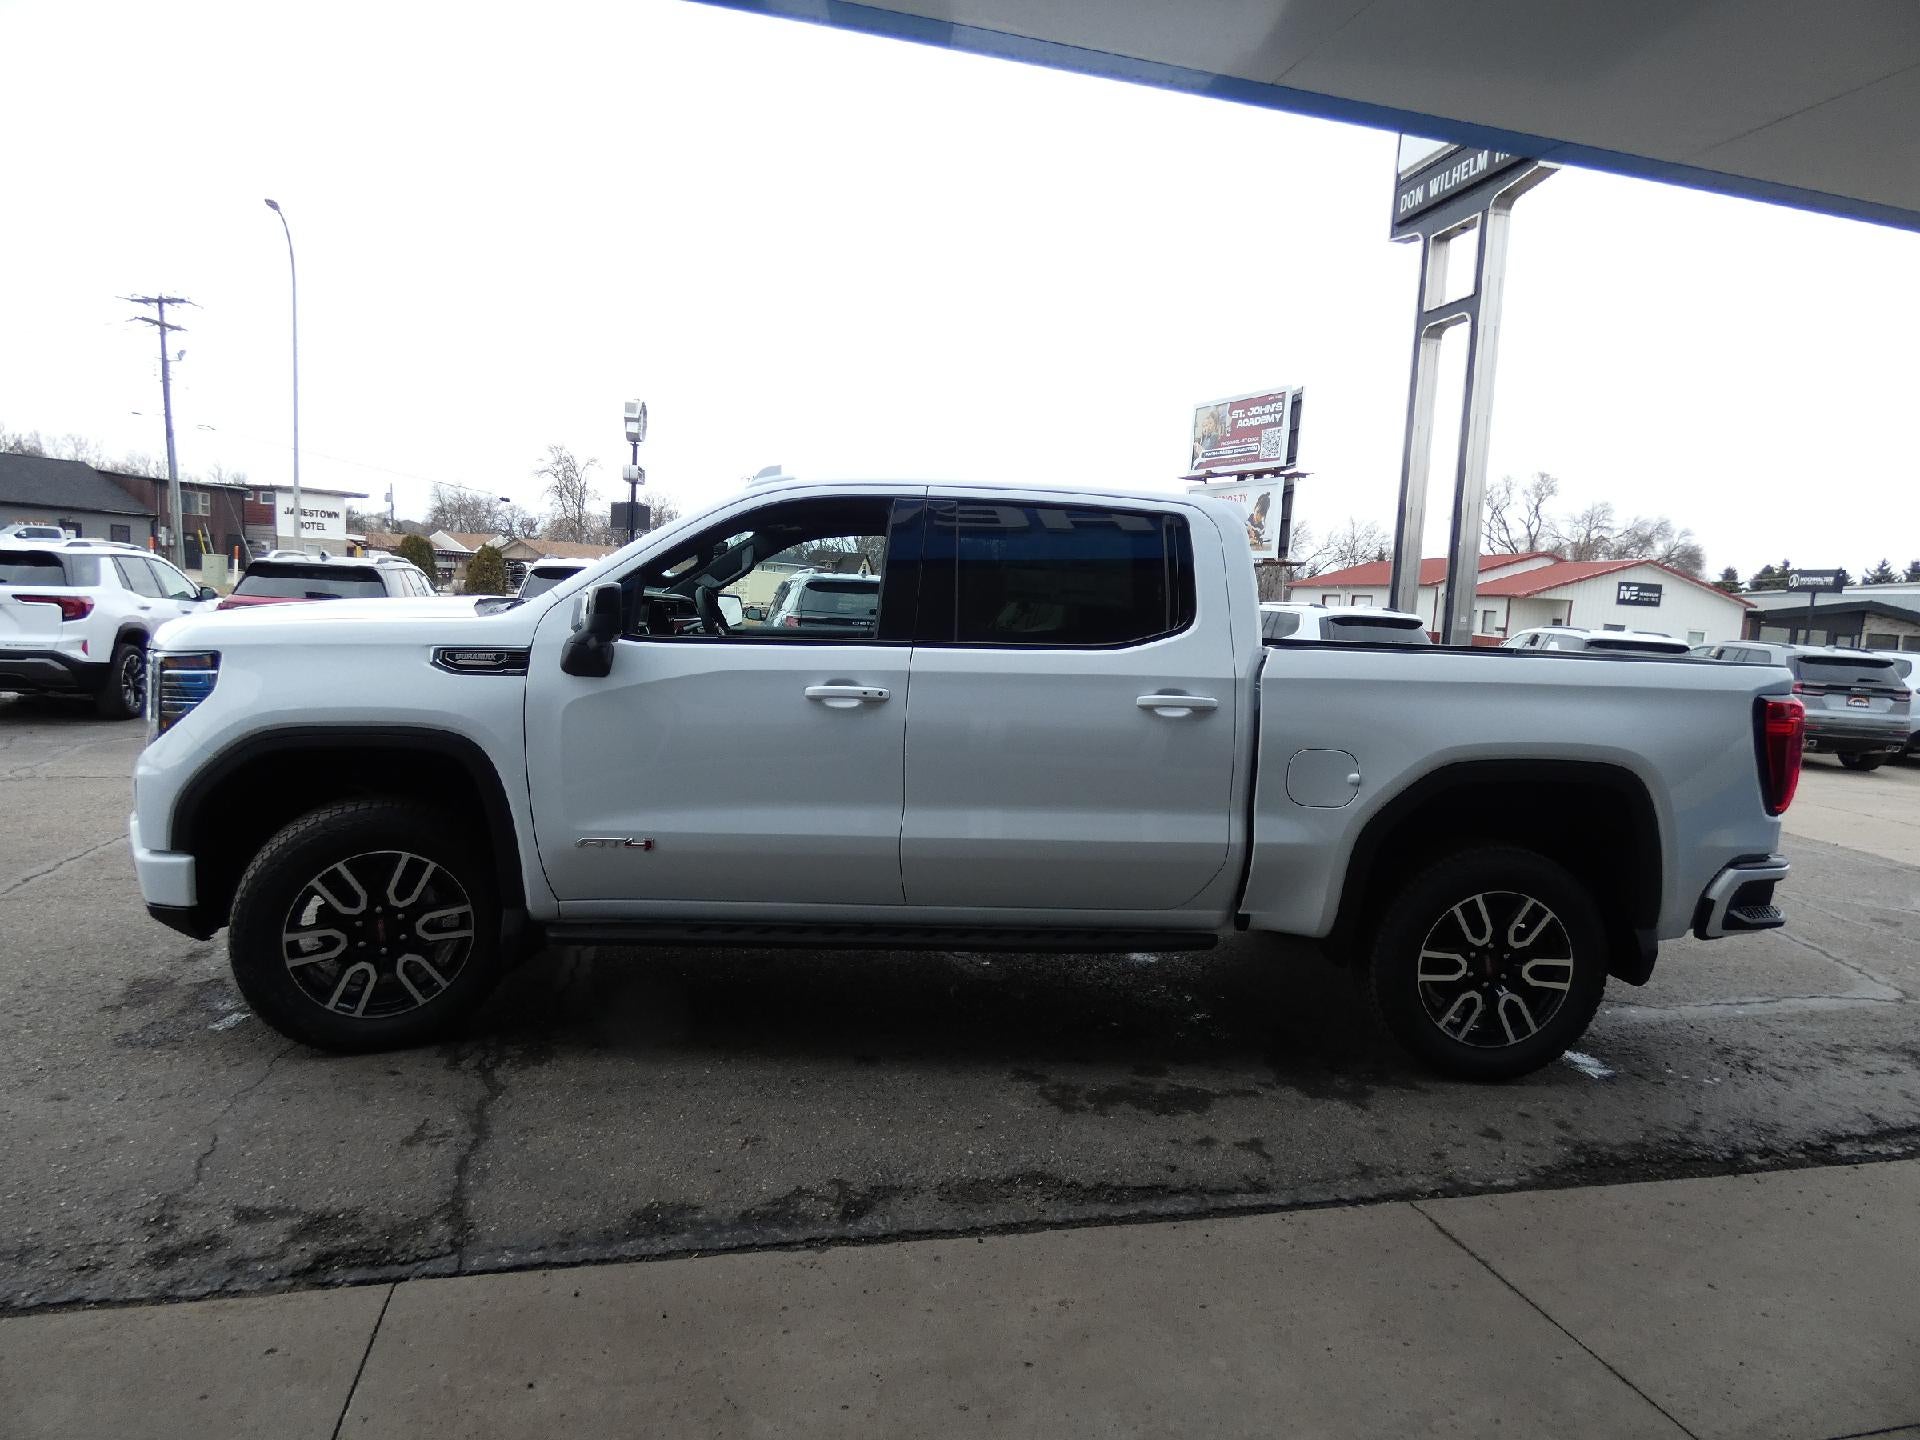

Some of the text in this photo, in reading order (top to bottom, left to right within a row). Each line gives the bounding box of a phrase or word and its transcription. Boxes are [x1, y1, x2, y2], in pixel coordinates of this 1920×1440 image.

[1400, 150, 1488, 213] DON WILHELM
[1232, 402, 1283, 419] ST. JOHN'S
[1236, 413, 1283, 429] ACADEMY
